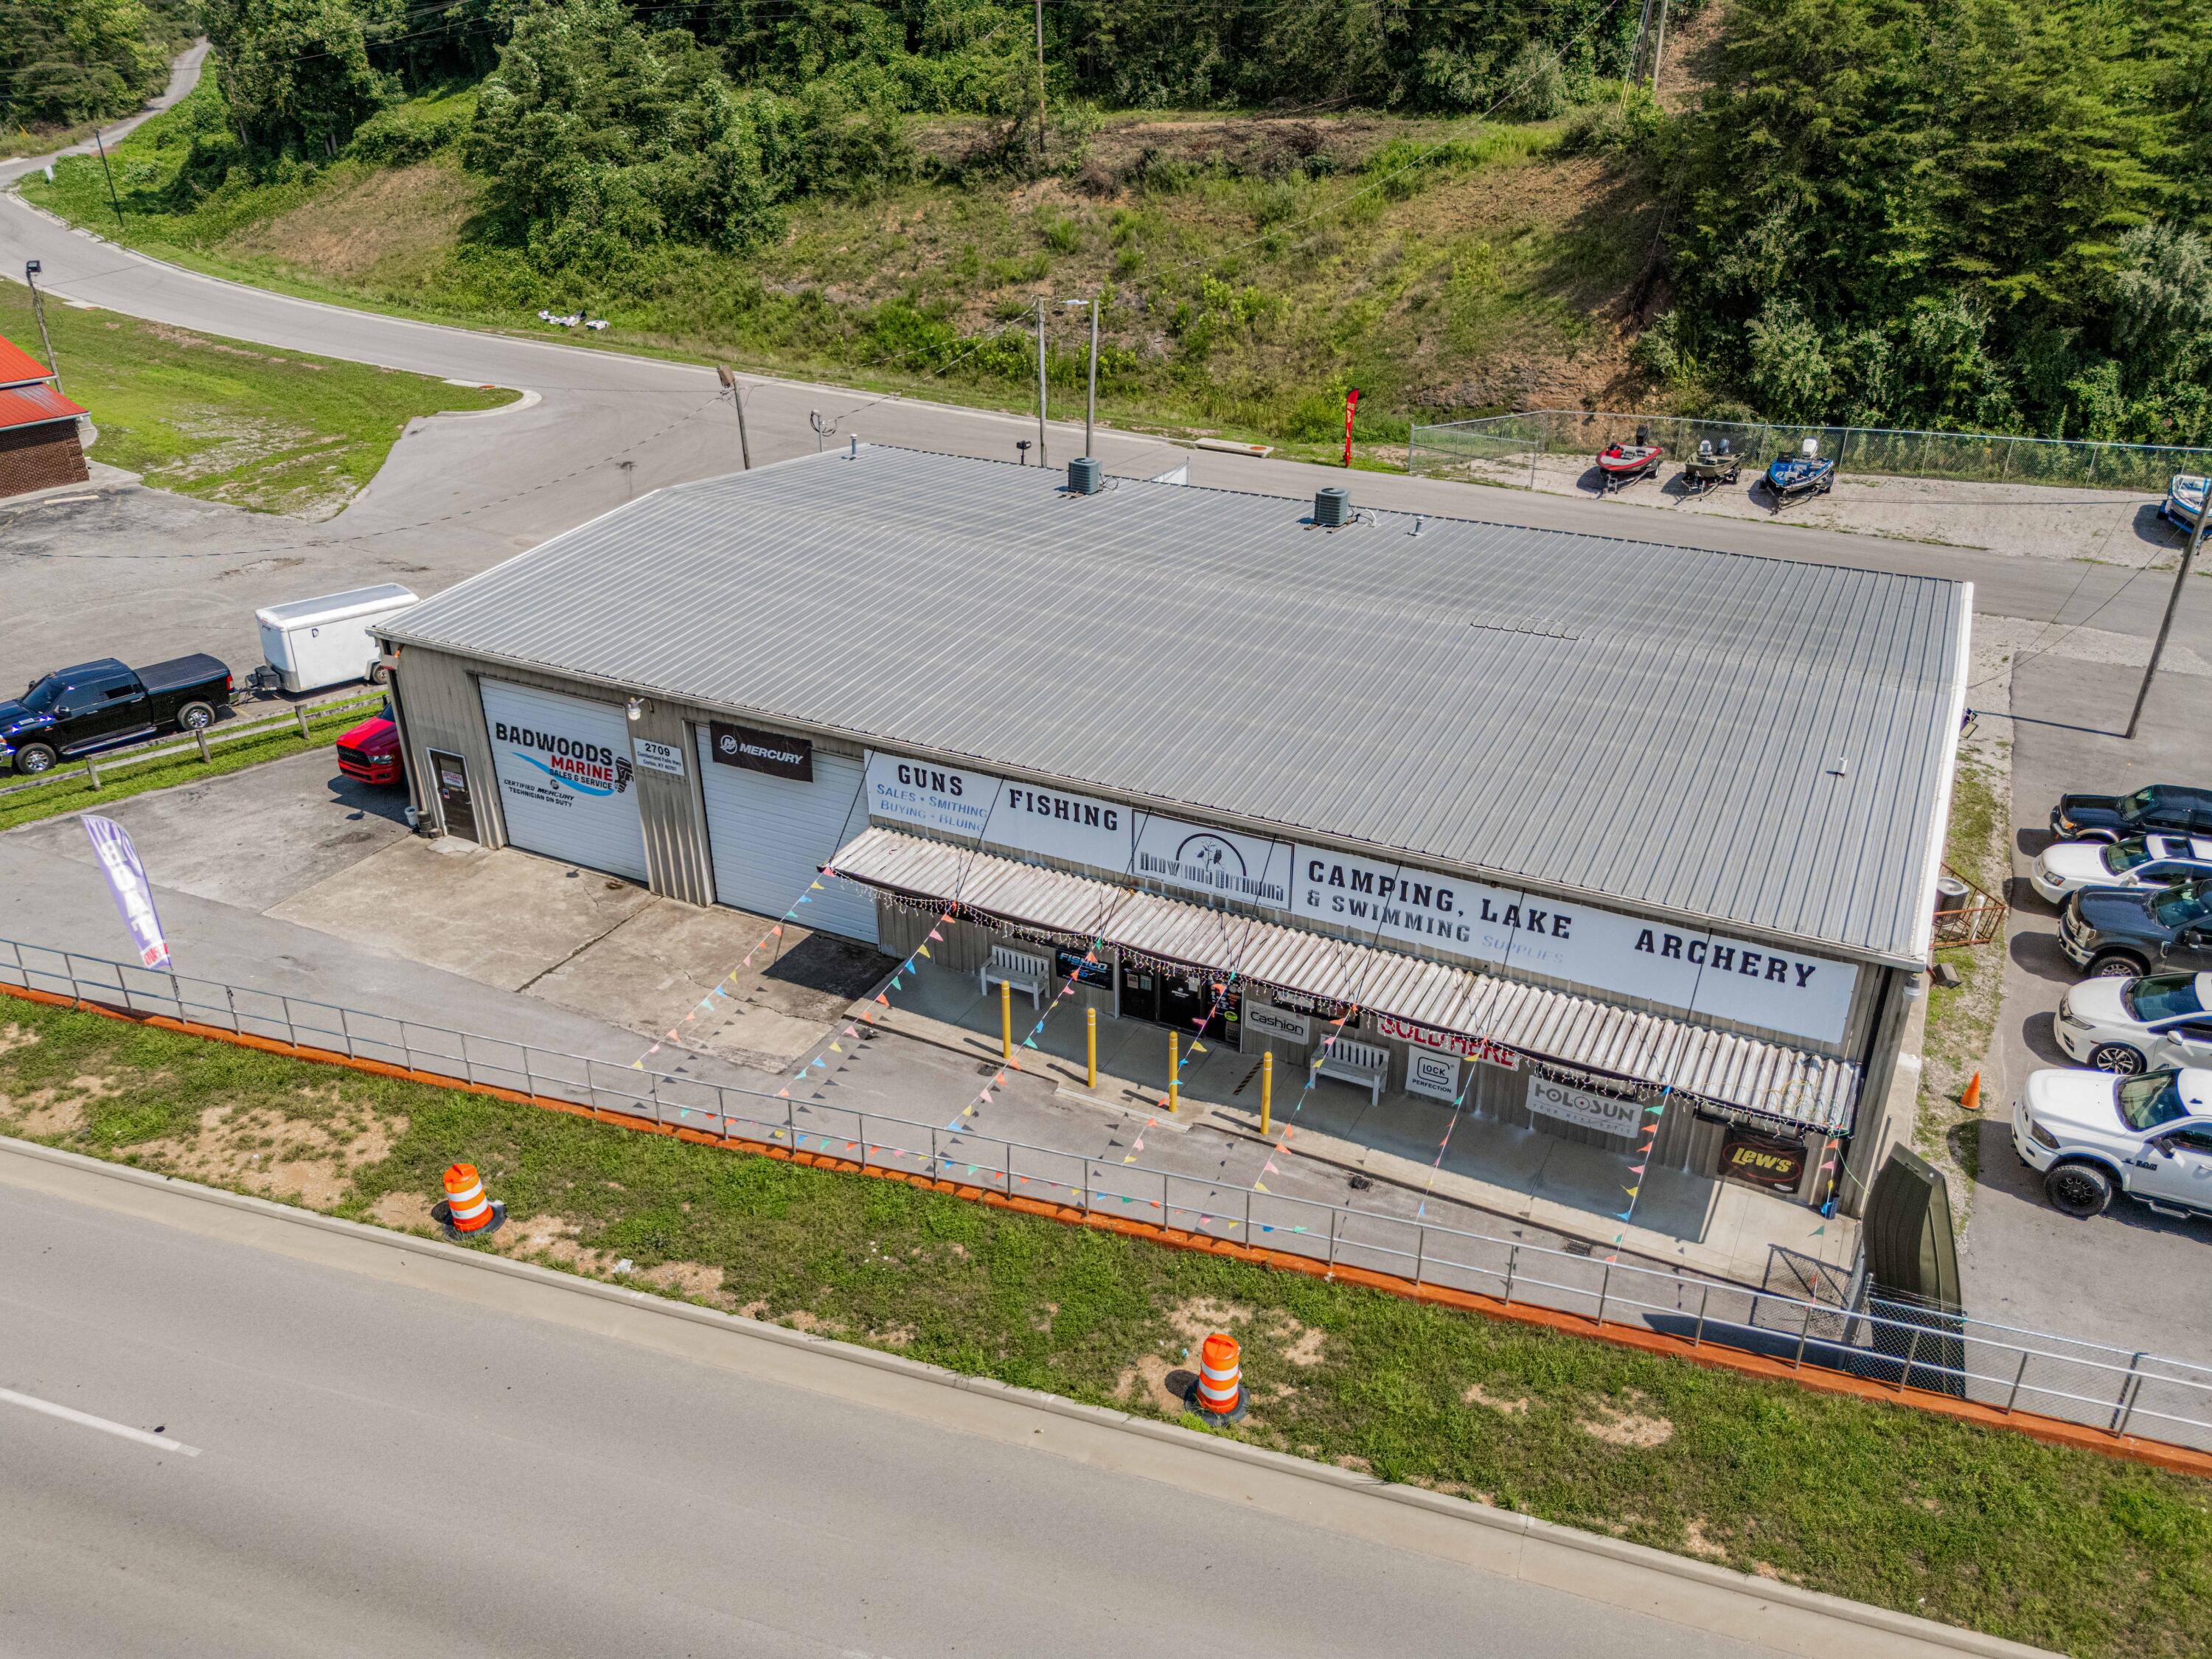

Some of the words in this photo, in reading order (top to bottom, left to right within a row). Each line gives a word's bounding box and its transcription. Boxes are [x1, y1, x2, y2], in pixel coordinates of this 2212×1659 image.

[495, 722, 613, 766] BADWOODS
[637, 751, 661, 761] Cumberland
[645, 742, 670, 757] 2709
[739, 742, 804, 765] MERCURY
[549, 769, 572, 781] SALES
[581, 776, 613, 790] SERVICE
[552, 755, 613, 782] MARINE
[898, 764, 963, 796] GUNS
[504, 779, 535, 791] CERTIFIED
[537, 787, 575, 801] MERCURY
[509, 786, 545, 801] TECHNICIAN
[555, 799, 572, 807] DUTY
[877, 784, 916, 802] SALES
[929, 796, 987, 818] SMITHING
[880, 799, 926, 819] BUYING
[939, 814, 984, 833] BLUING
[1009, 788, 1117, 831] FISHING
[1309, 860, 1464, 917] CAMPING,
[1480, 898, 1572, 939] LAKE
[1307, 889, 1320, 907] &
[1332, 895, 1471, 942] SWIMMING
[1481, 935, 1564, 964] SUPPLIES
[1634, 928, 1816, 988] ARCHERY
[1250, 1011, 1304, 1035] Cashion
[1412, 1078, 1452, 1093] PERFECTION
[1533, 1103, 1558, 1114] YOUR
